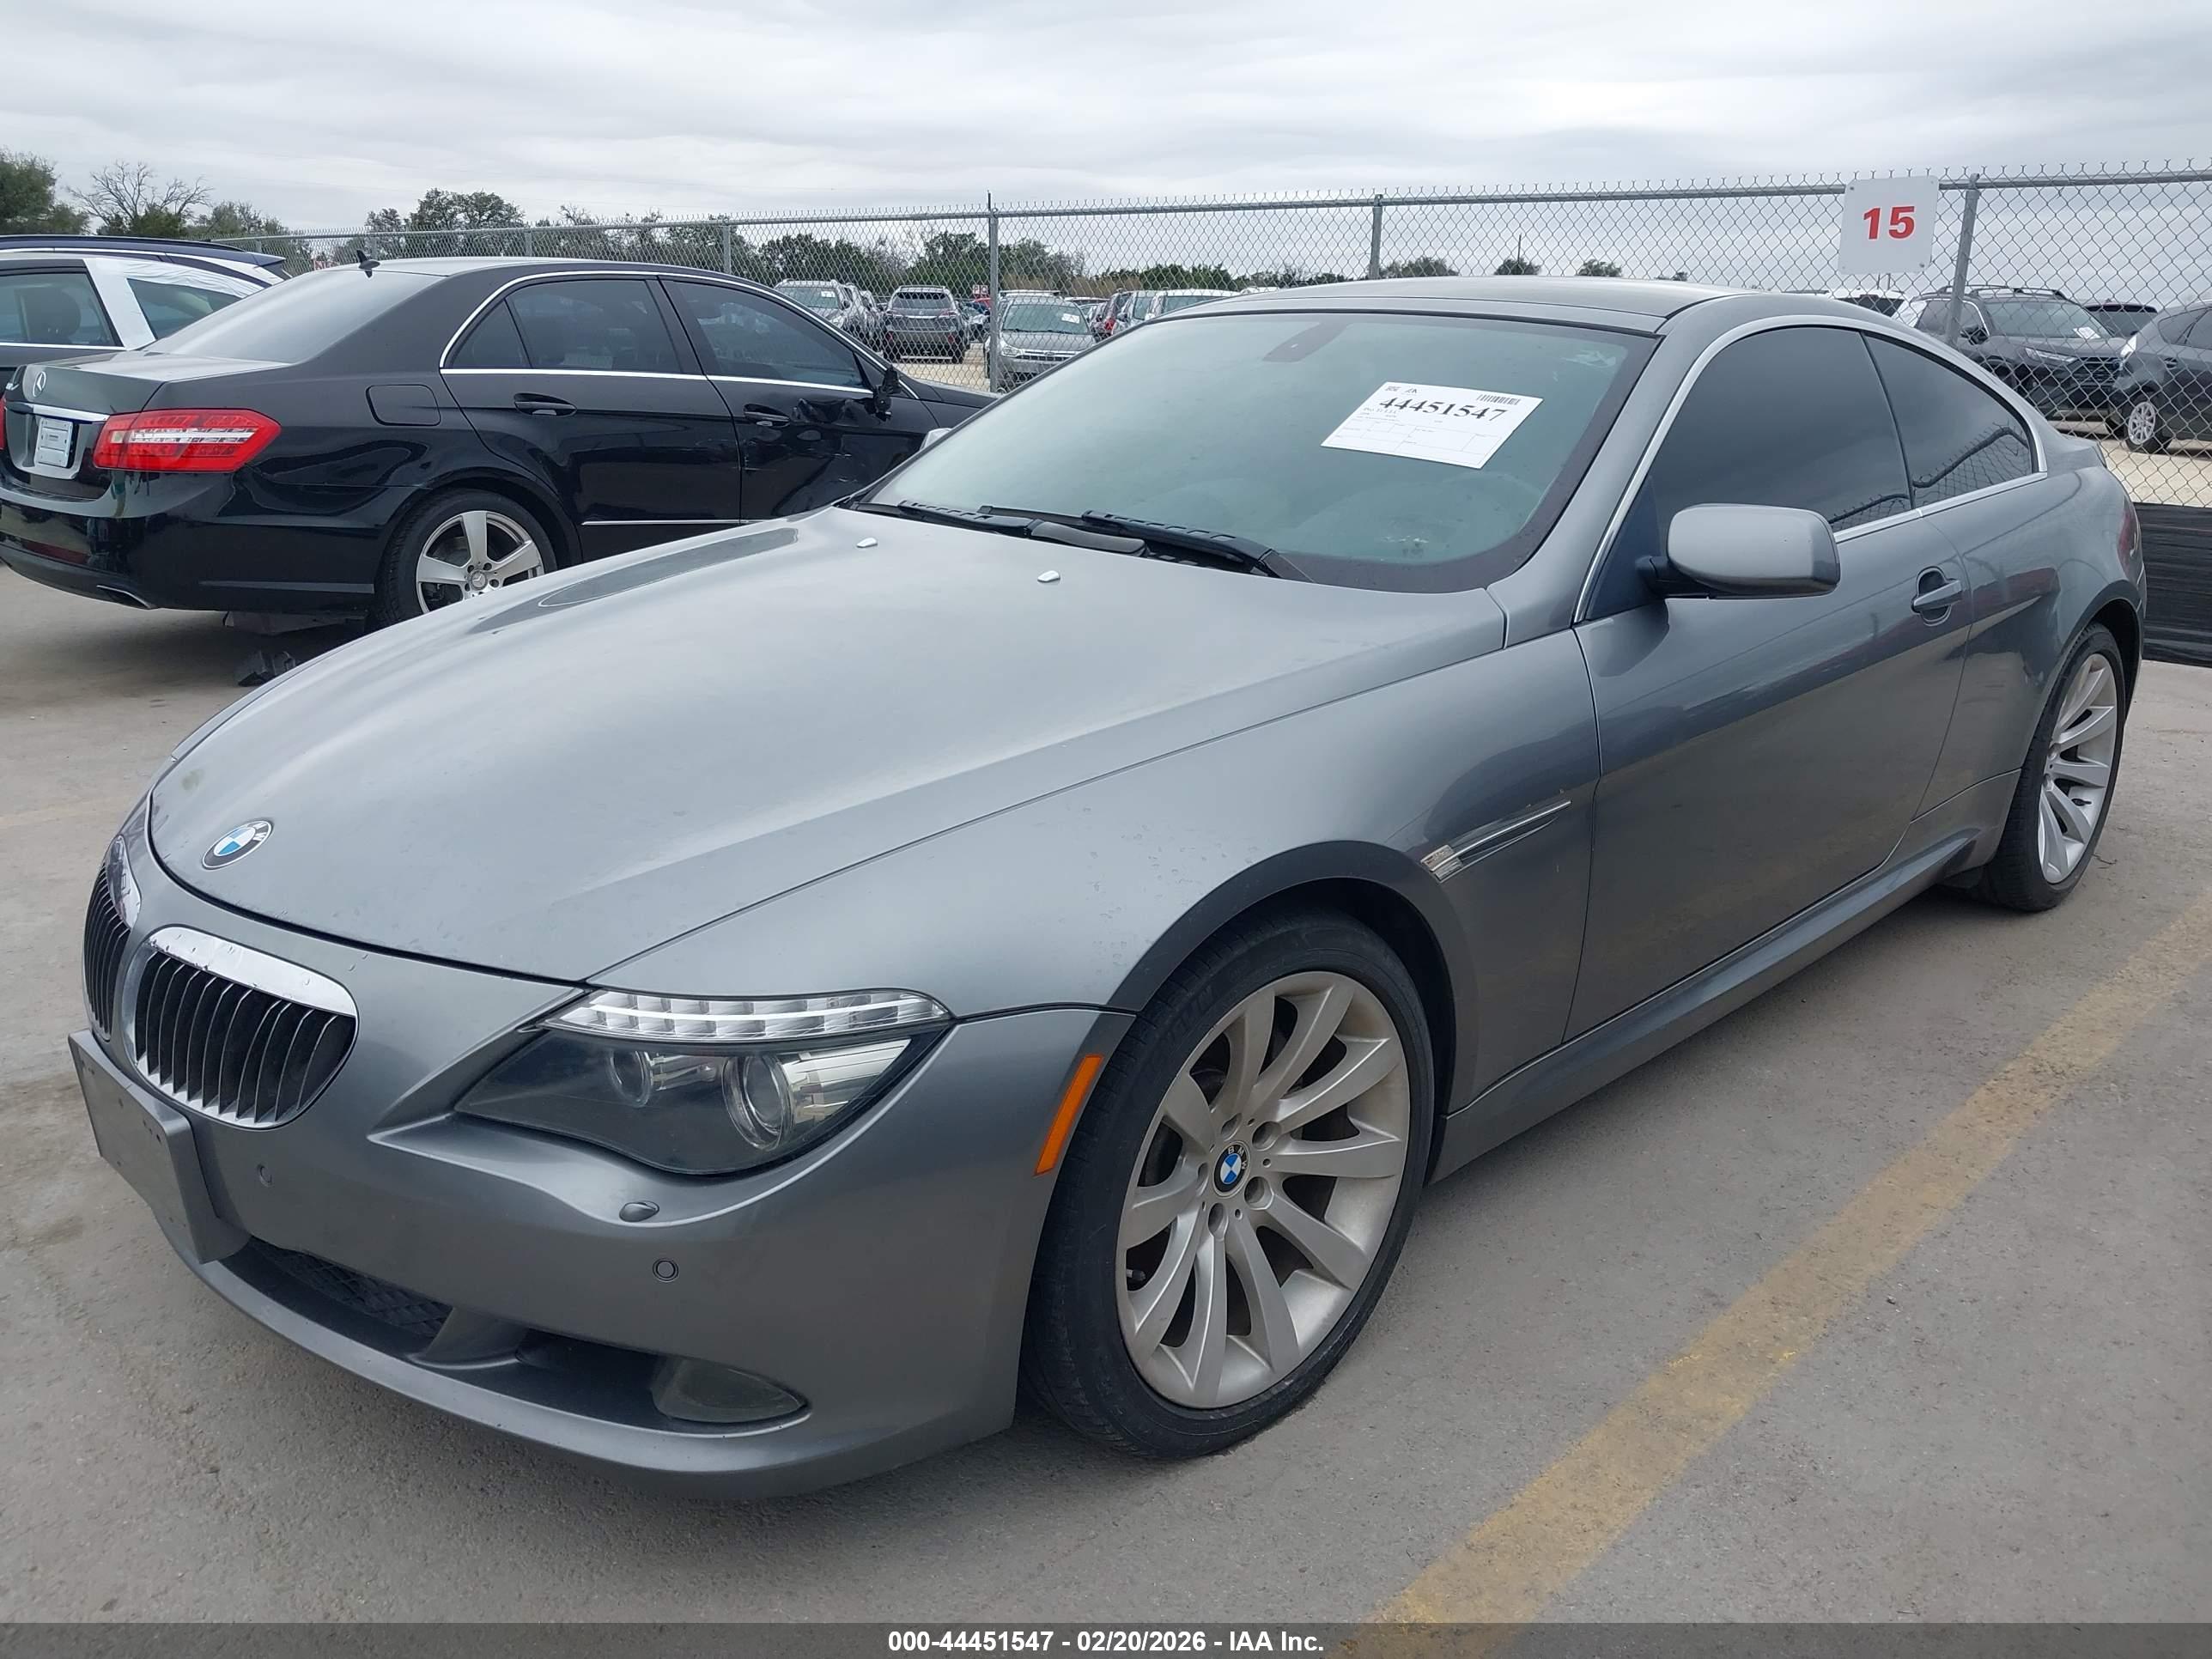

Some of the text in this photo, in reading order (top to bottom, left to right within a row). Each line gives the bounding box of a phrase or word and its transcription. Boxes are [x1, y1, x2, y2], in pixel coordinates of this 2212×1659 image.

[1863, 205, 1915, 240] 15
[1227, 287, 1248, 311] BMW
[1378, 397, 1508, 422] 44451547
